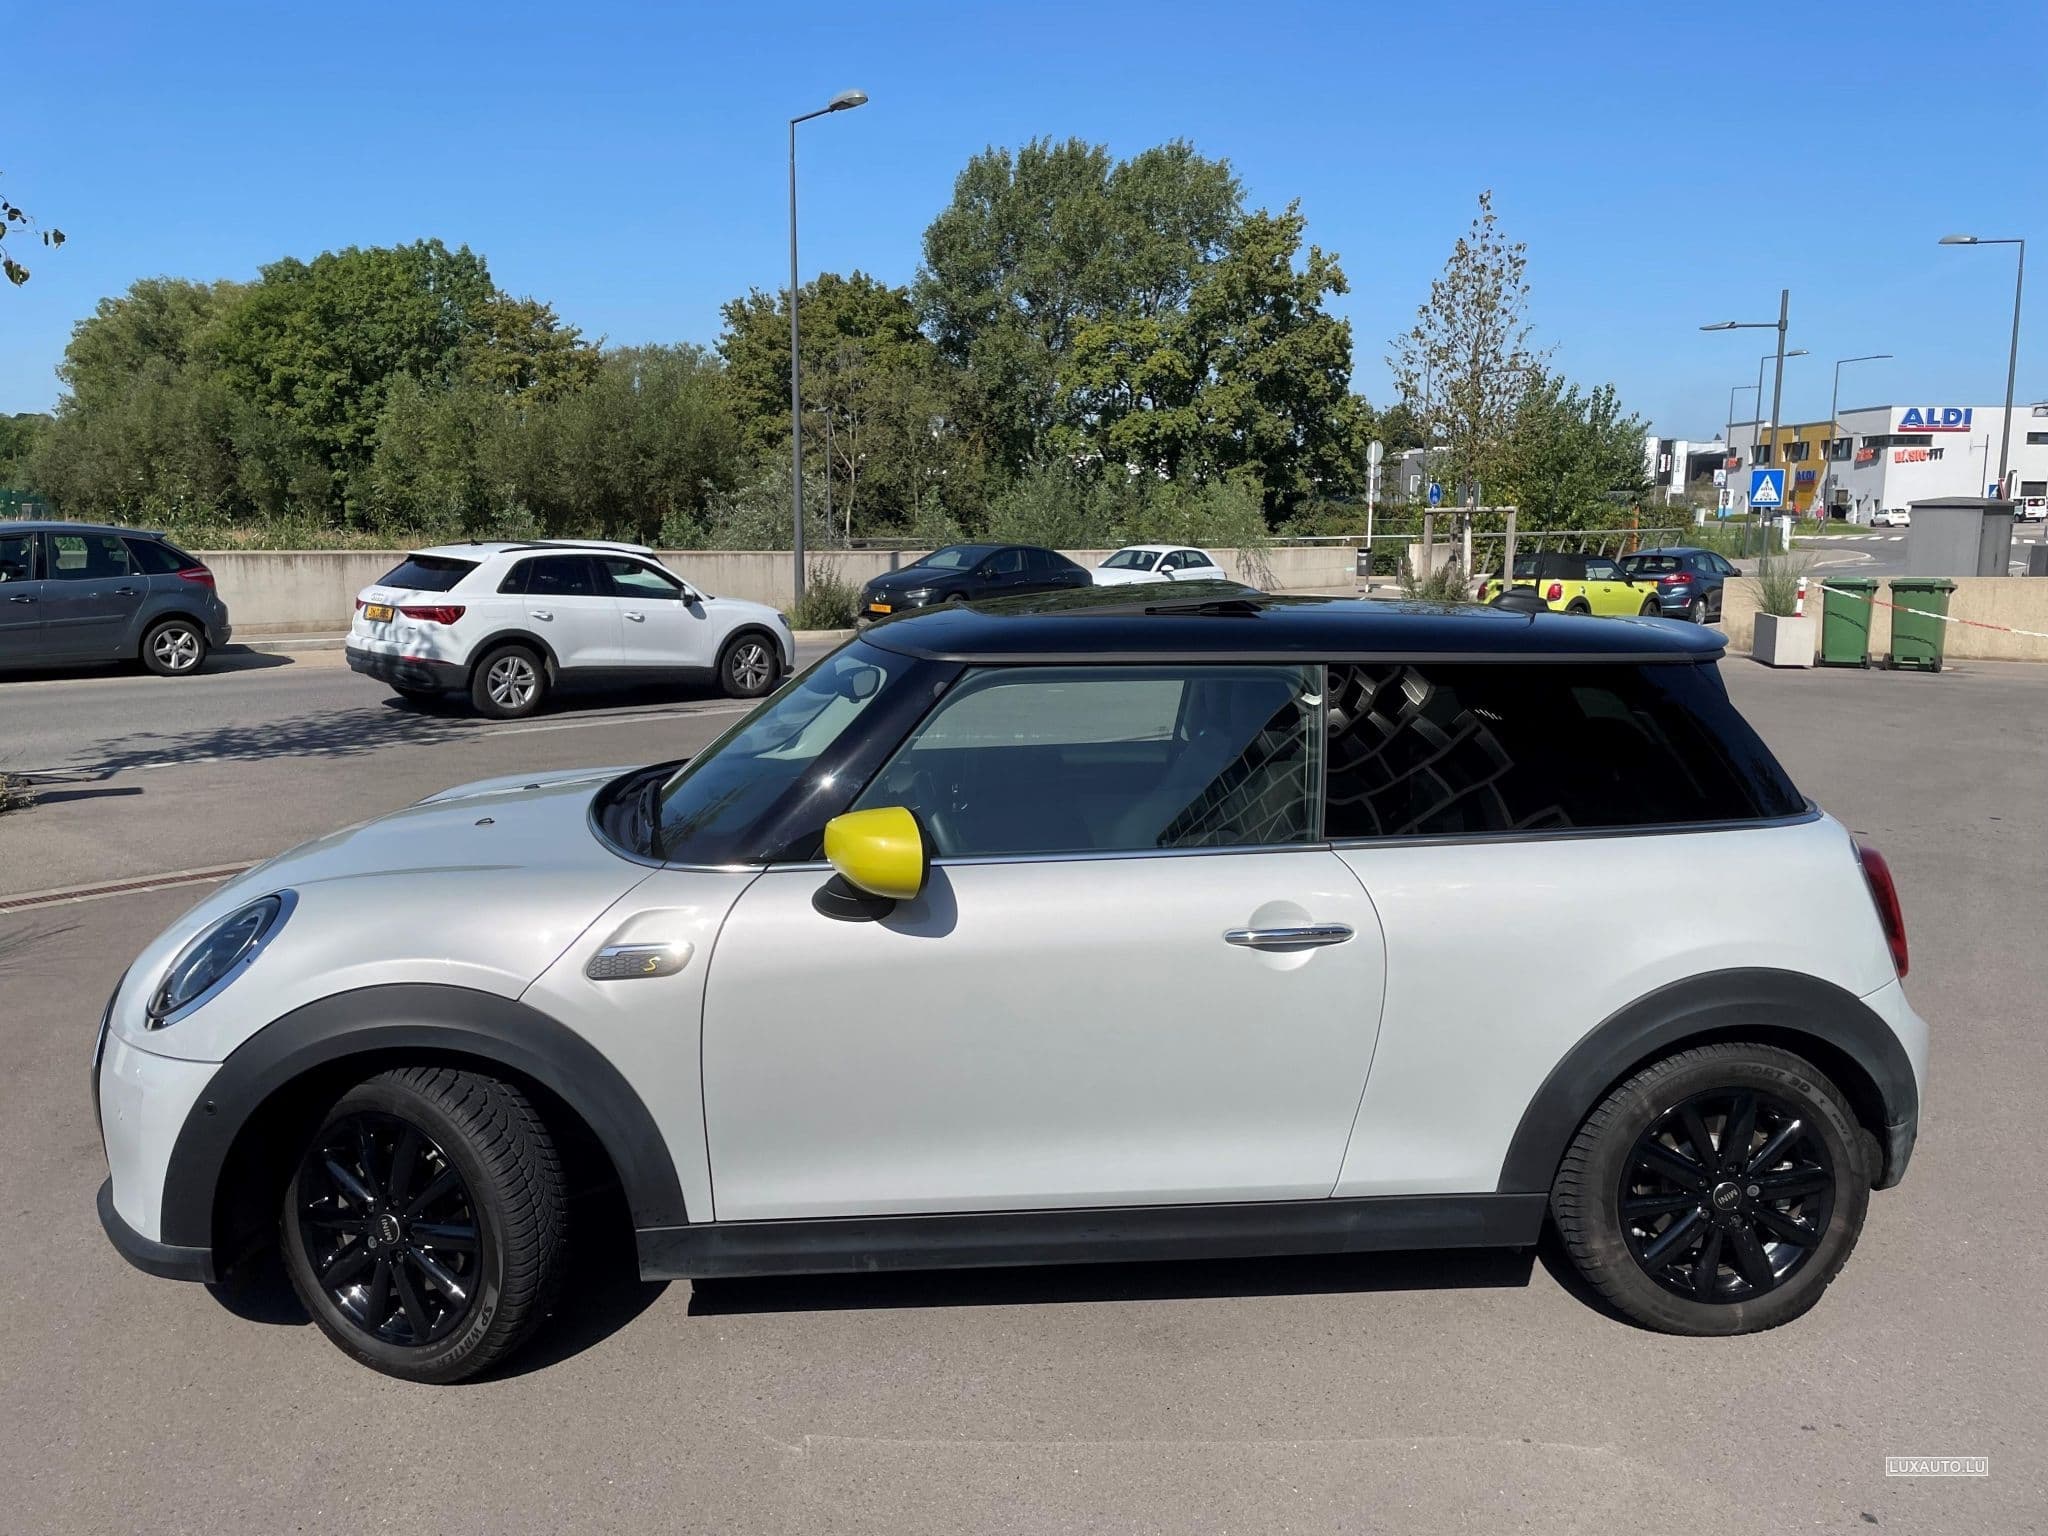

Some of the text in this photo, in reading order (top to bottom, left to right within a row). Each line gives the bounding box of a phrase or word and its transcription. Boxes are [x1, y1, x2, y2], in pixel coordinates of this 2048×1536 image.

[1899, 407, 1973, 426] ALDI
[1796, 469, 1817, 481] ALDI
[642, 956, 661, 972] S
[1718, 1189, 1738, 1204] MINI
[381, 1219, 393, 1241] MINI
